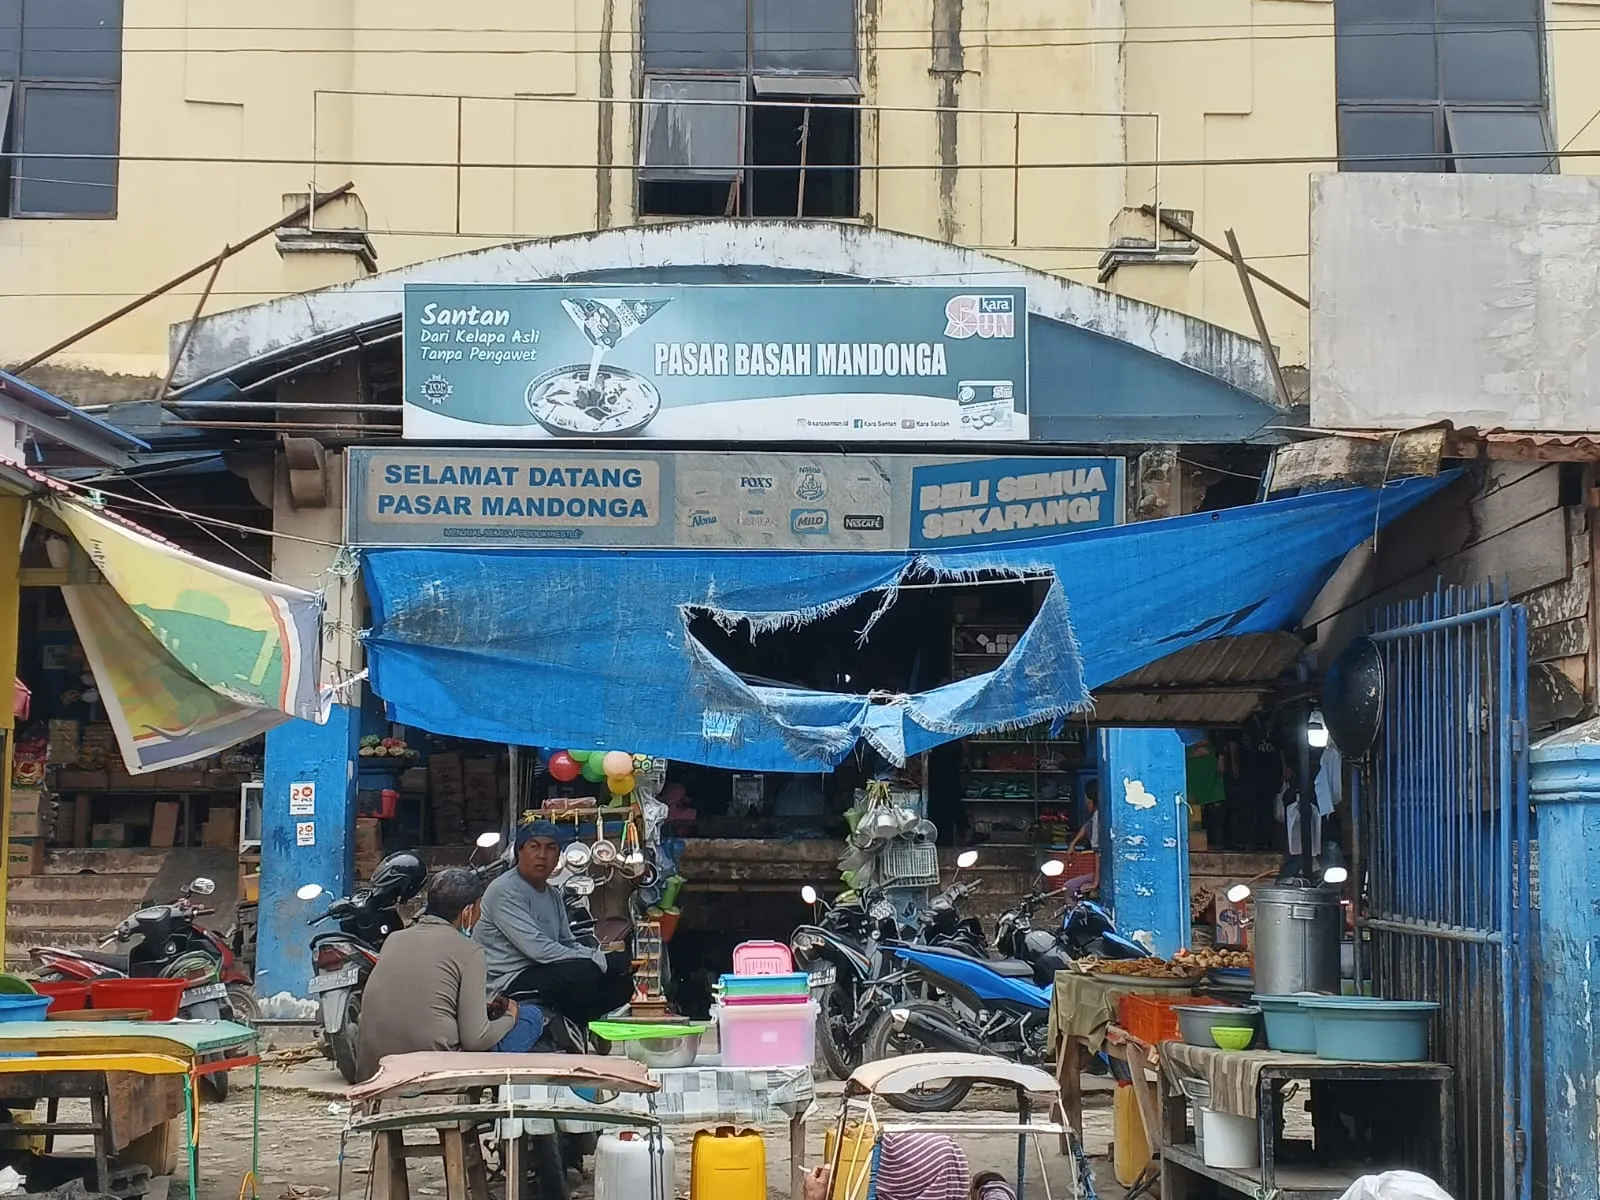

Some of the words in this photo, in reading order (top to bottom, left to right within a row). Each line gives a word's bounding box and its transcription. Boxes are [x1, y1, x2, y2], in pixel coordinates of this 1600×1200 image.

[419, 302, 511, 327] Santan
[981, 297, 1009, 311] kara
[420, 329, 451, 344] Dari
[455, 329, 506, 346] Kelapa
[511, 329, 540, 344] Asli
[420, 346, 464, 364] Tanpa
[468, 347, 537, 365] Pengawet
[654, 342, 730, 377] PASAR
[733, 342, 812, 377] BASAH
[816, 342, 948, 377] MANDONGA
[384, 463, 519, 487] SELAMAT
[528, 466, 643, 489] DATANG
[919, 479, 990, 511] BELI
[996, 466, 1108, 502] SEMUA
[377, 494, 473, 516] PASAR
[481, 496, 650, 519] MANDONGA
